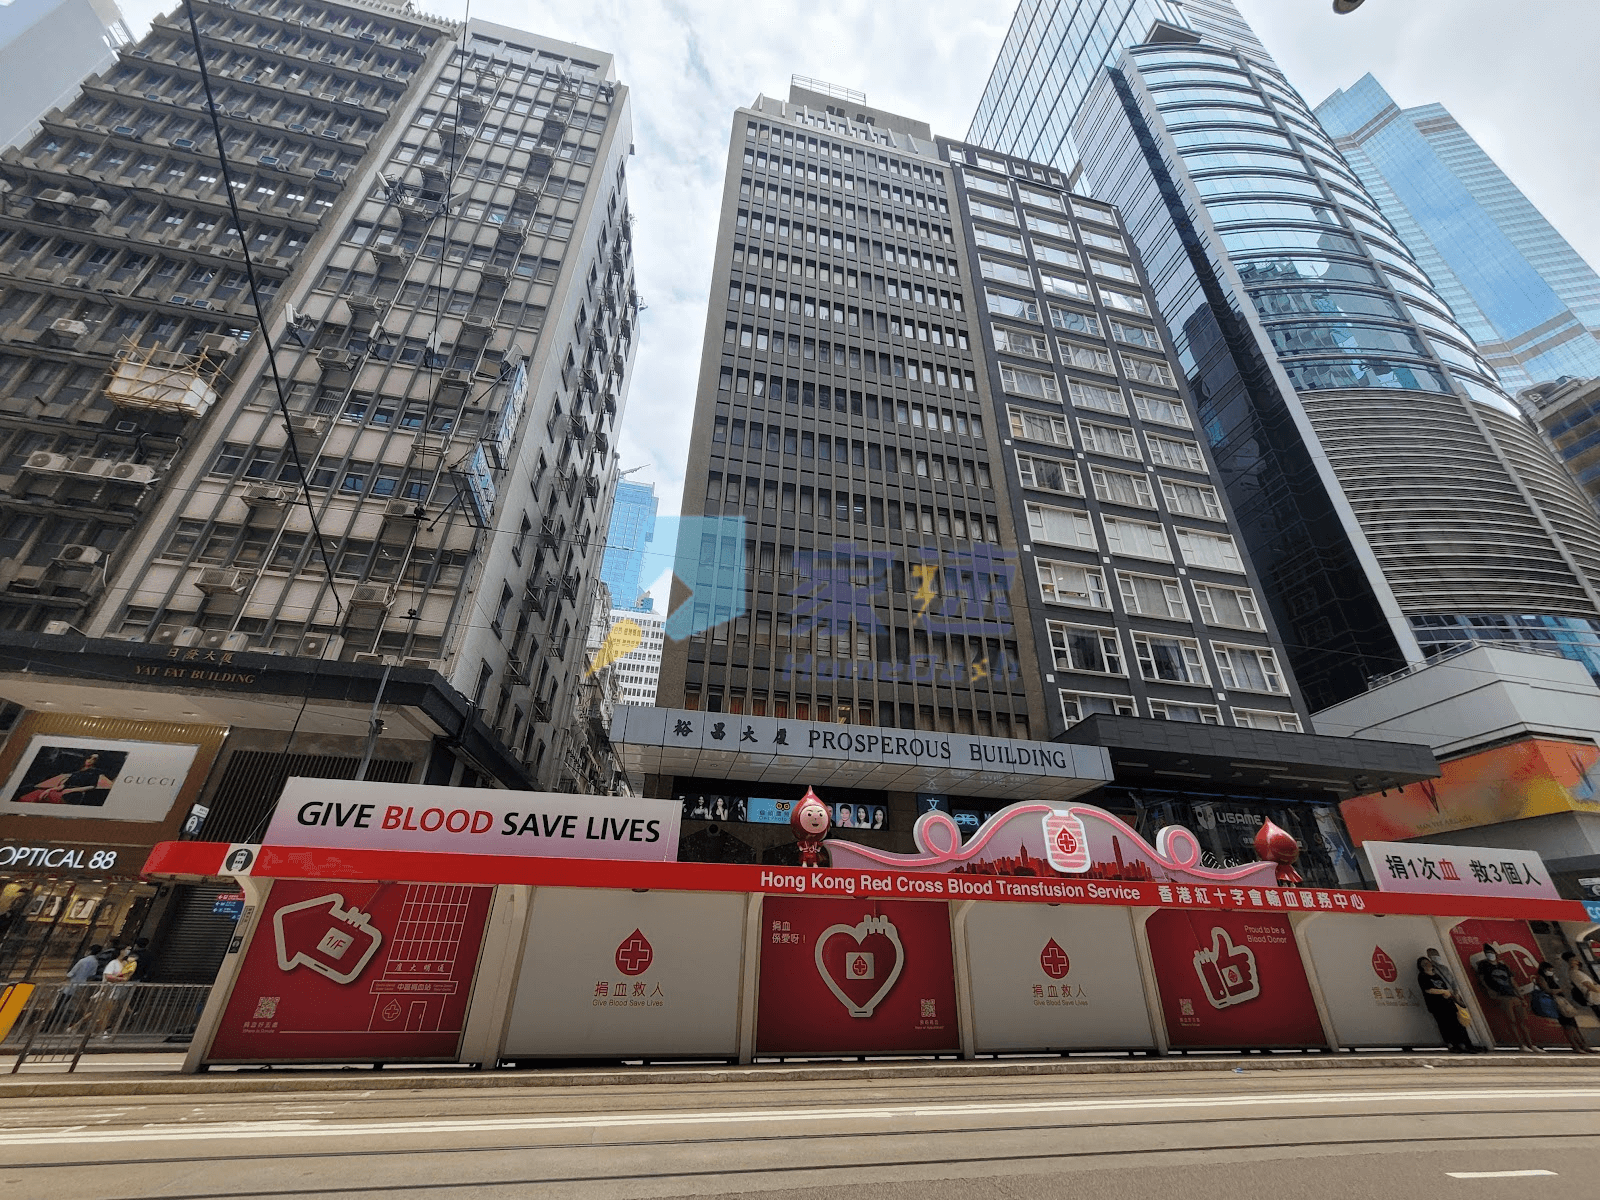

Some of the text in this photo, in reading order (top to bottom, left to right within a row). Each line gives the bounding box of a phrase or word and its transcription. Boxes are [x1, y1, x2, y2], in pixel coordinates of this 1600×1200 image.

[135, 665, 256, 684] YAT FAT BUILDING
[808, 729, 1067, 769] PROSPEROUS BUILDING
[123, 775, 176, 787] GUCCI
[297, 801, 661, 843] GIVE BLOOD SAVE LIVES
[1216, 812, 1264, 825] UGAME
[0, 846, 118, 870] OPTICAL 88
[1385, 854, 1542, 886] 捐1次血 救3個人
[760, 871, 1141, 900] Hong Kong Red Cross Blood Transfusion Service
[1157, 885, 1366, 911] 香港紅十字會輸血服務中心
[1243, 925, 1264, 934] Proud
[1271, 926, 1280, 934] be
[326, 935, 347, 950] 1/F
[1246, 935, 1287, 944] Blood Donor
[594, 980, 664, 998] 捐血救人
[1032, 984, 1087, 998] 捐血救人
[592, 998, 664, 1007] Give Blood Save Lives
